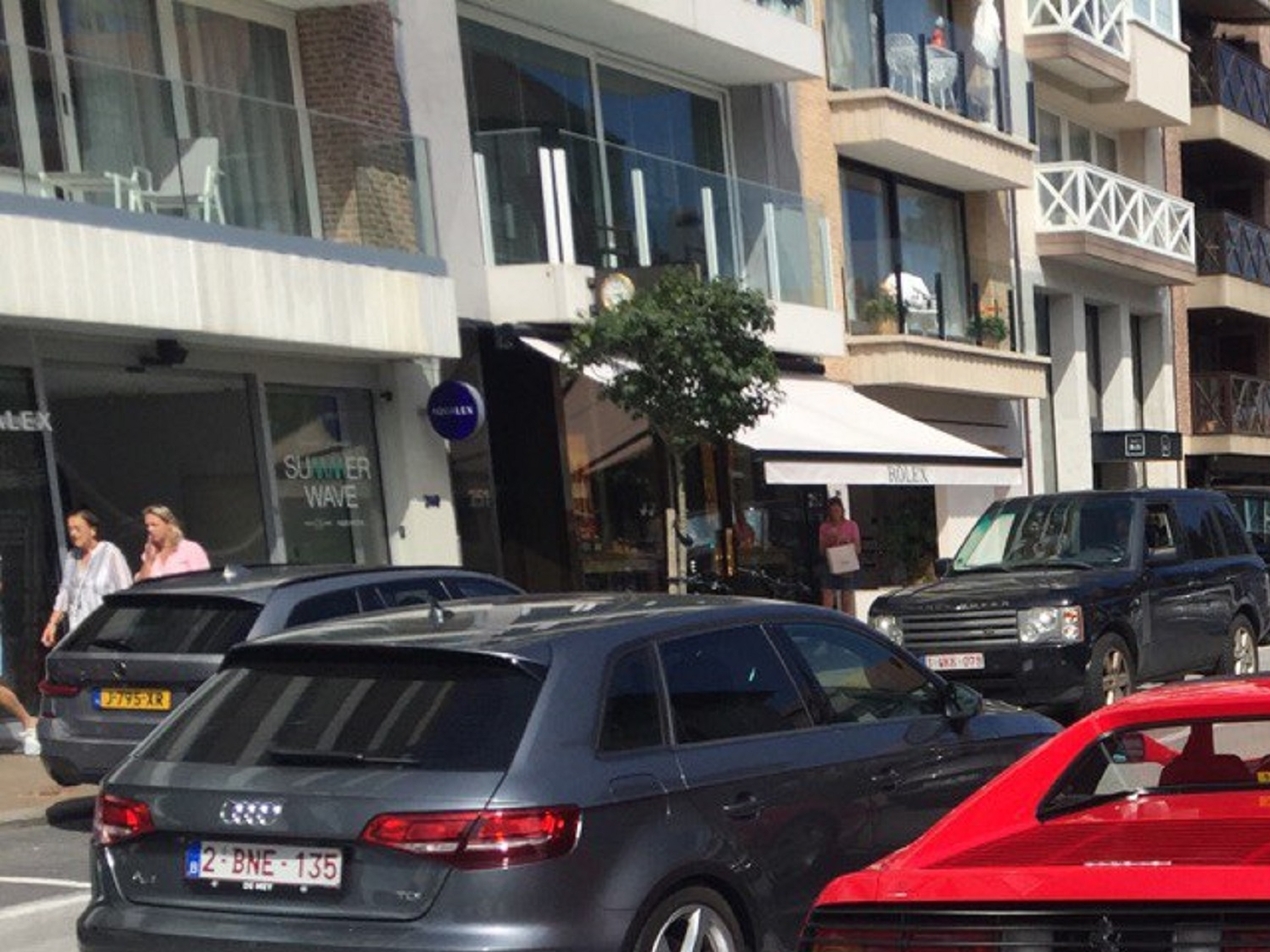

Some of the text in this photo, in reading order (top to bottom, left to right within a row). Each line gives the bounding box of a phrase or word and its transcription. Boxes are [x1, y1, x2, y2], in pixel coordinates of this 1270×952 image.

[887, 465, 930, 483] ROLEX
[303, 484, 359, 508] WAVE
[202, 846, 338, 880] 2-BNE-135
